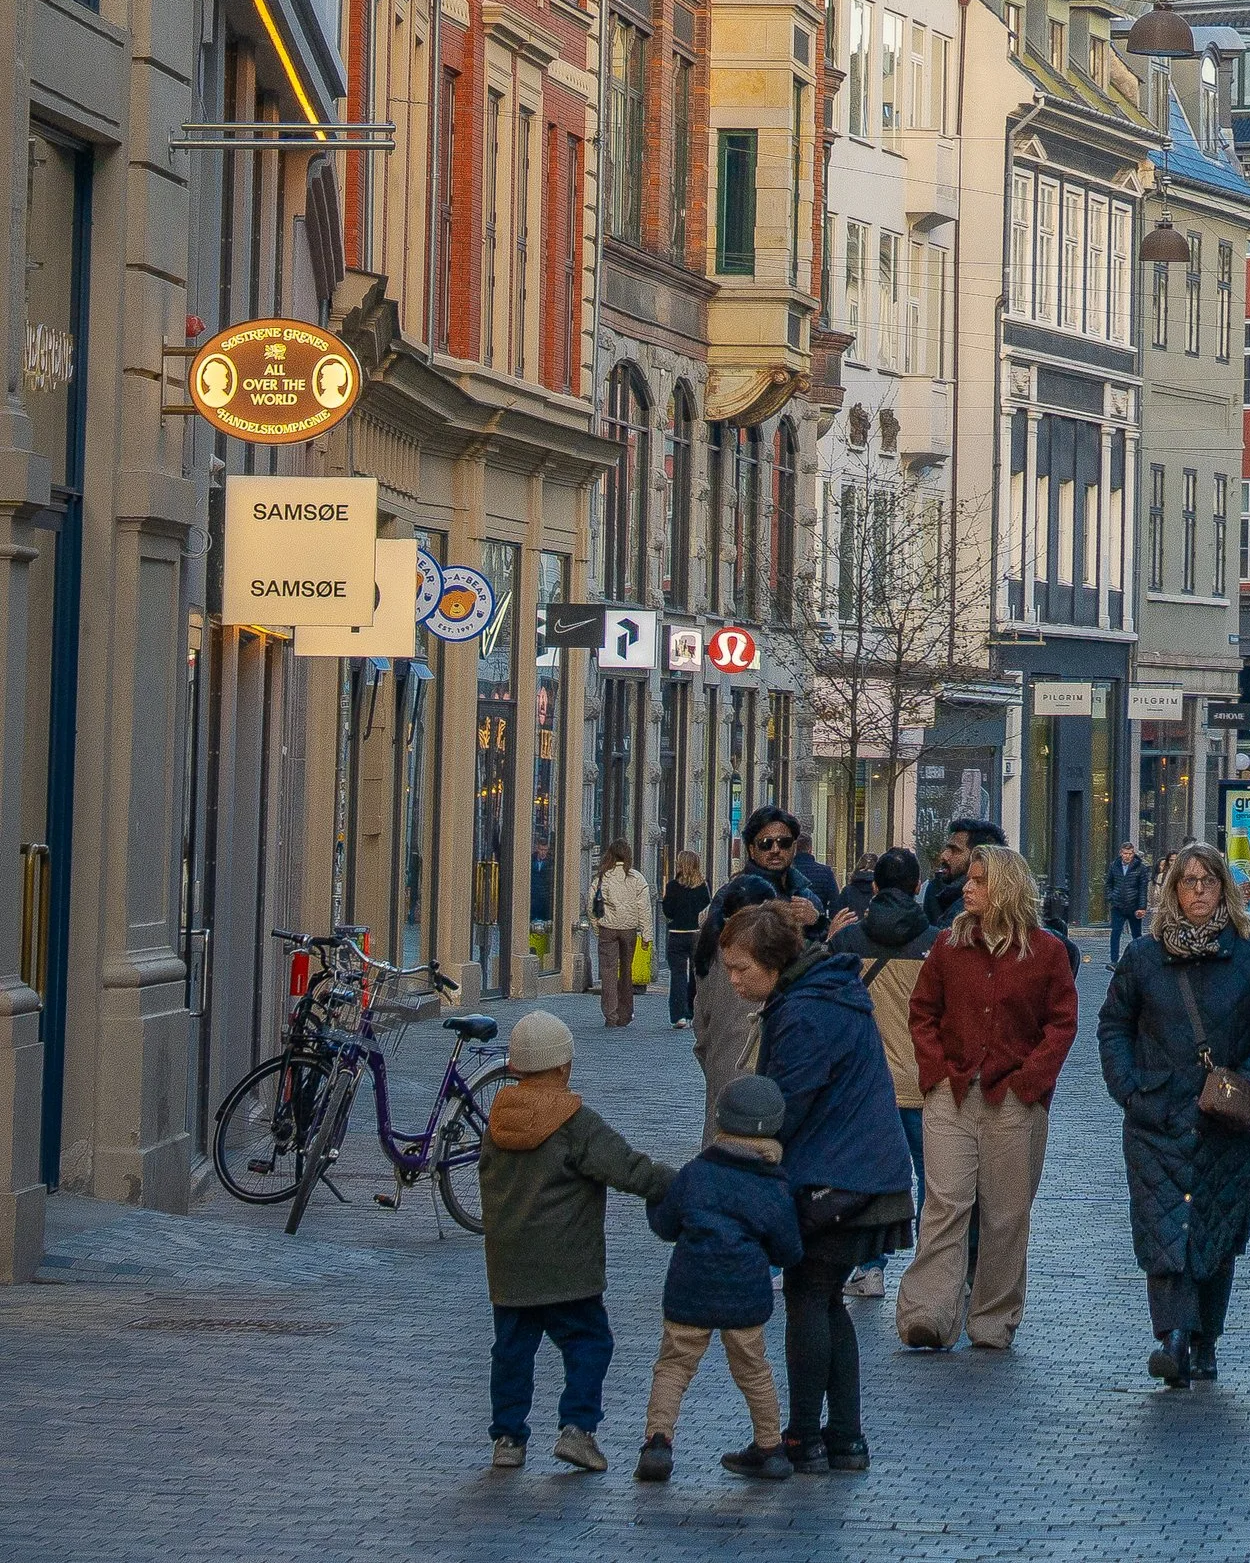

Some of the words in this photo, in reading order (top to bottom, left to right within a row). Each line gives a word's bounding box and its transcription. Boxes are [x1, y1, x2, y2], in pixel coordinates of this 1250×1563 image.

[221, 327, 281, 352] SØSTRENE
[283, 328, 330, 352] GRENES
[263, 364, 286, 376] ALL
[242, 379, 278, 391] OVER
[282, 379, 306, 391] THE
[250, 393, 298, 406] WORLD
[216, 408, 331, 436] HANDELSKOMPAGNIE
[252, 503, 349, 522] SAMSØE
[250, 580, 347, 598] SAMSØE
[456, 623, 474, 634] 1997
[1042, 694, 1083, 702] PILGRIM
[1132, 697, 1178, 705] PILGRIM
